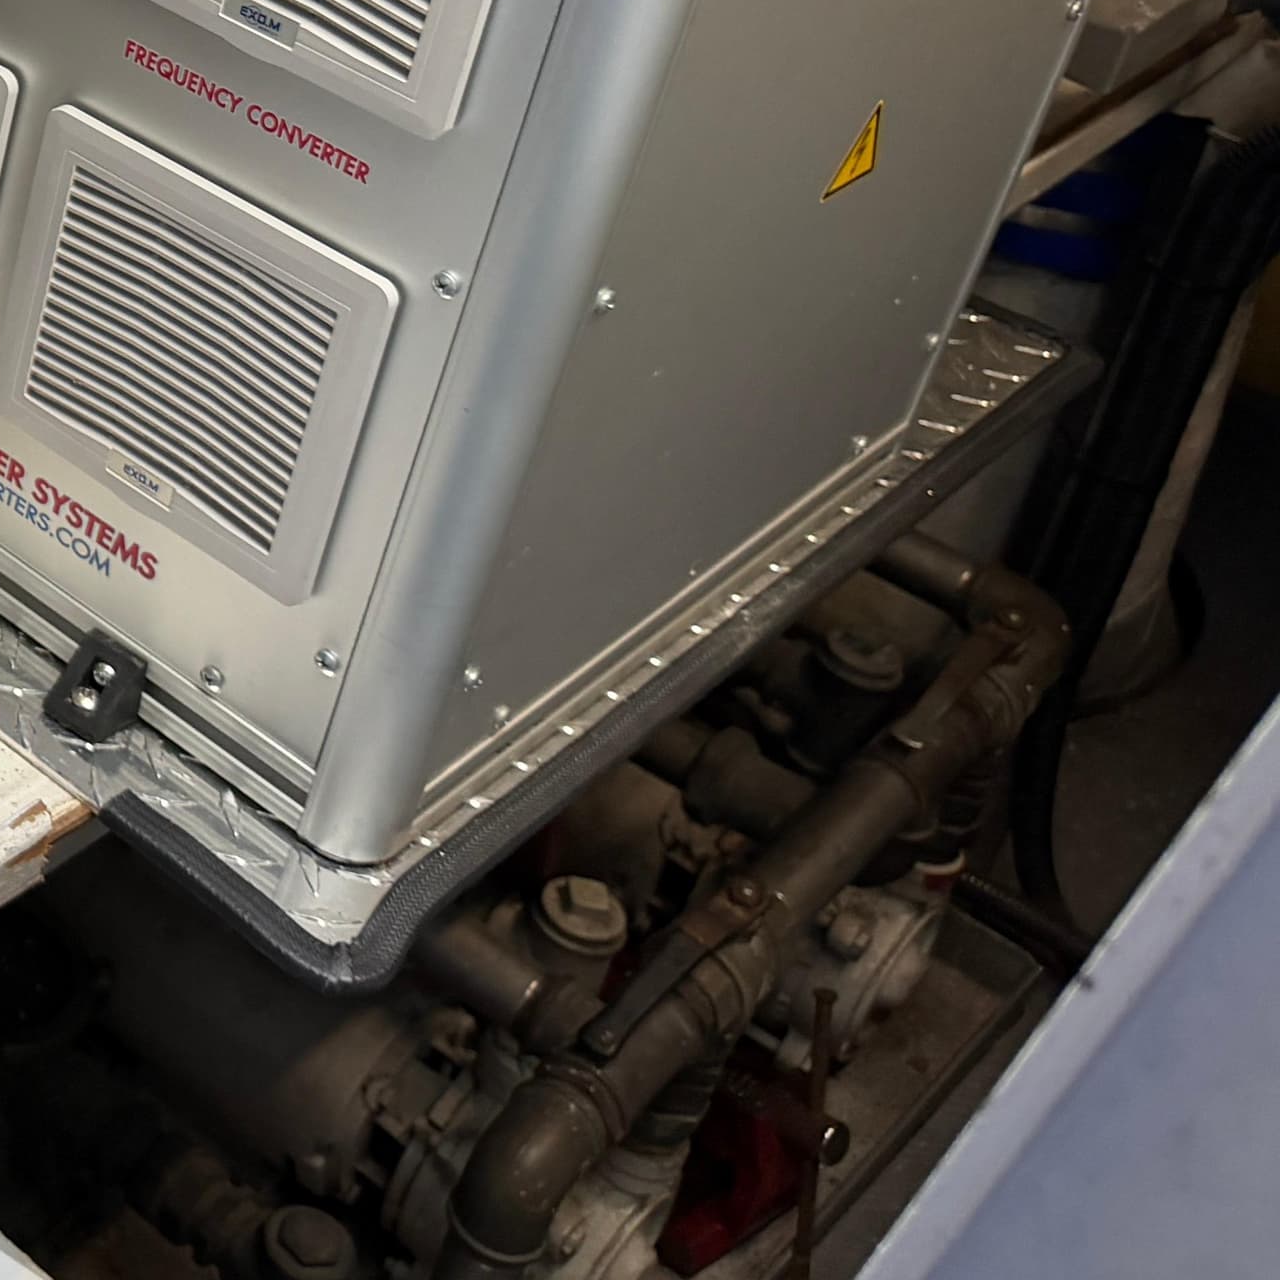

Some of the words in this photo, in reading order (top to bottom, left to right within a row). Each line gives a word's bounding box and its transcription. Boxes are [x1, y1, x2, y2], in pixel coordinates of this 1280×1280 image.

[123, 39, 244, 115] FREQUENCY
[246, 104, 372, 185] CONVERTER
[31, 477, 158, 581] SYSTEMS
